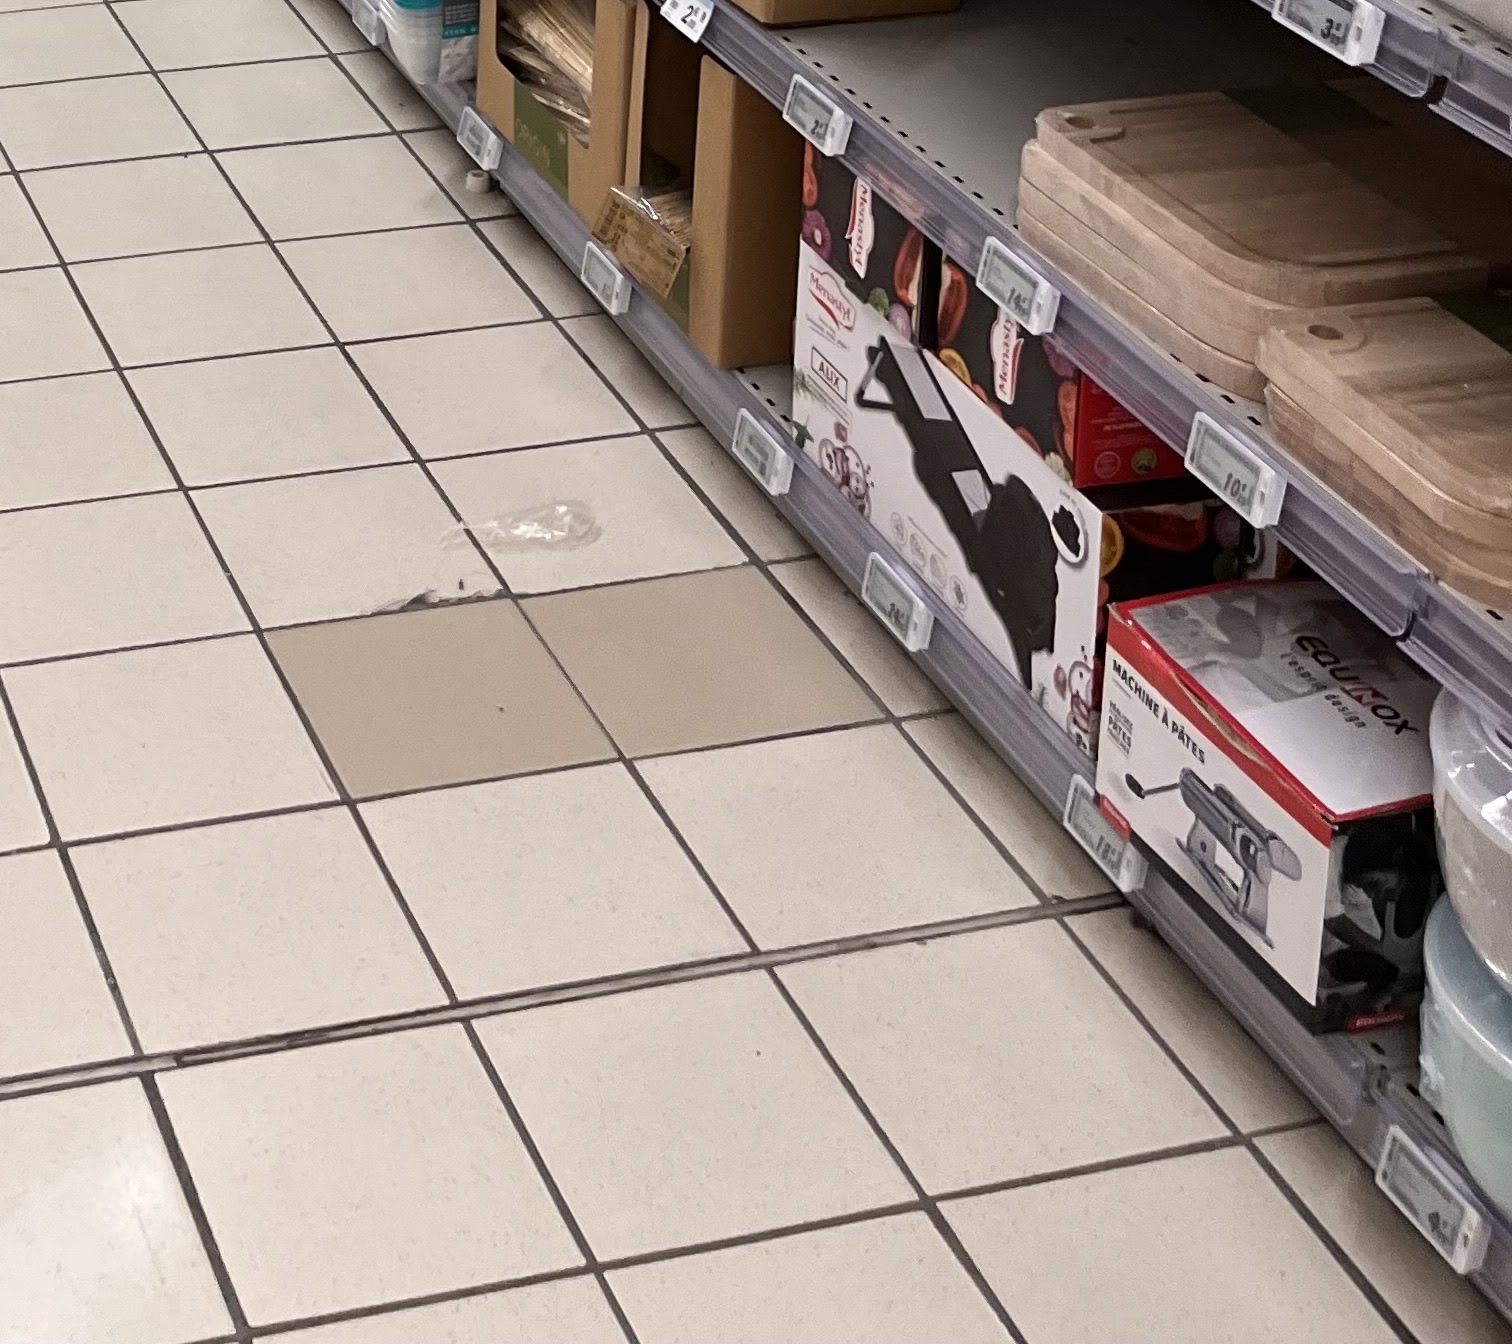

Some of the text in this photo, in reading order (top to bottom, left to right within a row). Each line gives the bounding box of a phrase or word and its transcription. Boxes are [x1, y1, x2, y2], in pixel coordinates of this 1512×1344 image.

[810, 272, 852, 323] Menastyl
[1112, 658, 1160, 719] MACHINE
[1161, 707, 1169, 730] À
[1171, 720, 1206, 765] PÂTES
[1294, 635, 1420, 735] EQUINOX
[1324, 694, 1366, 728] design
